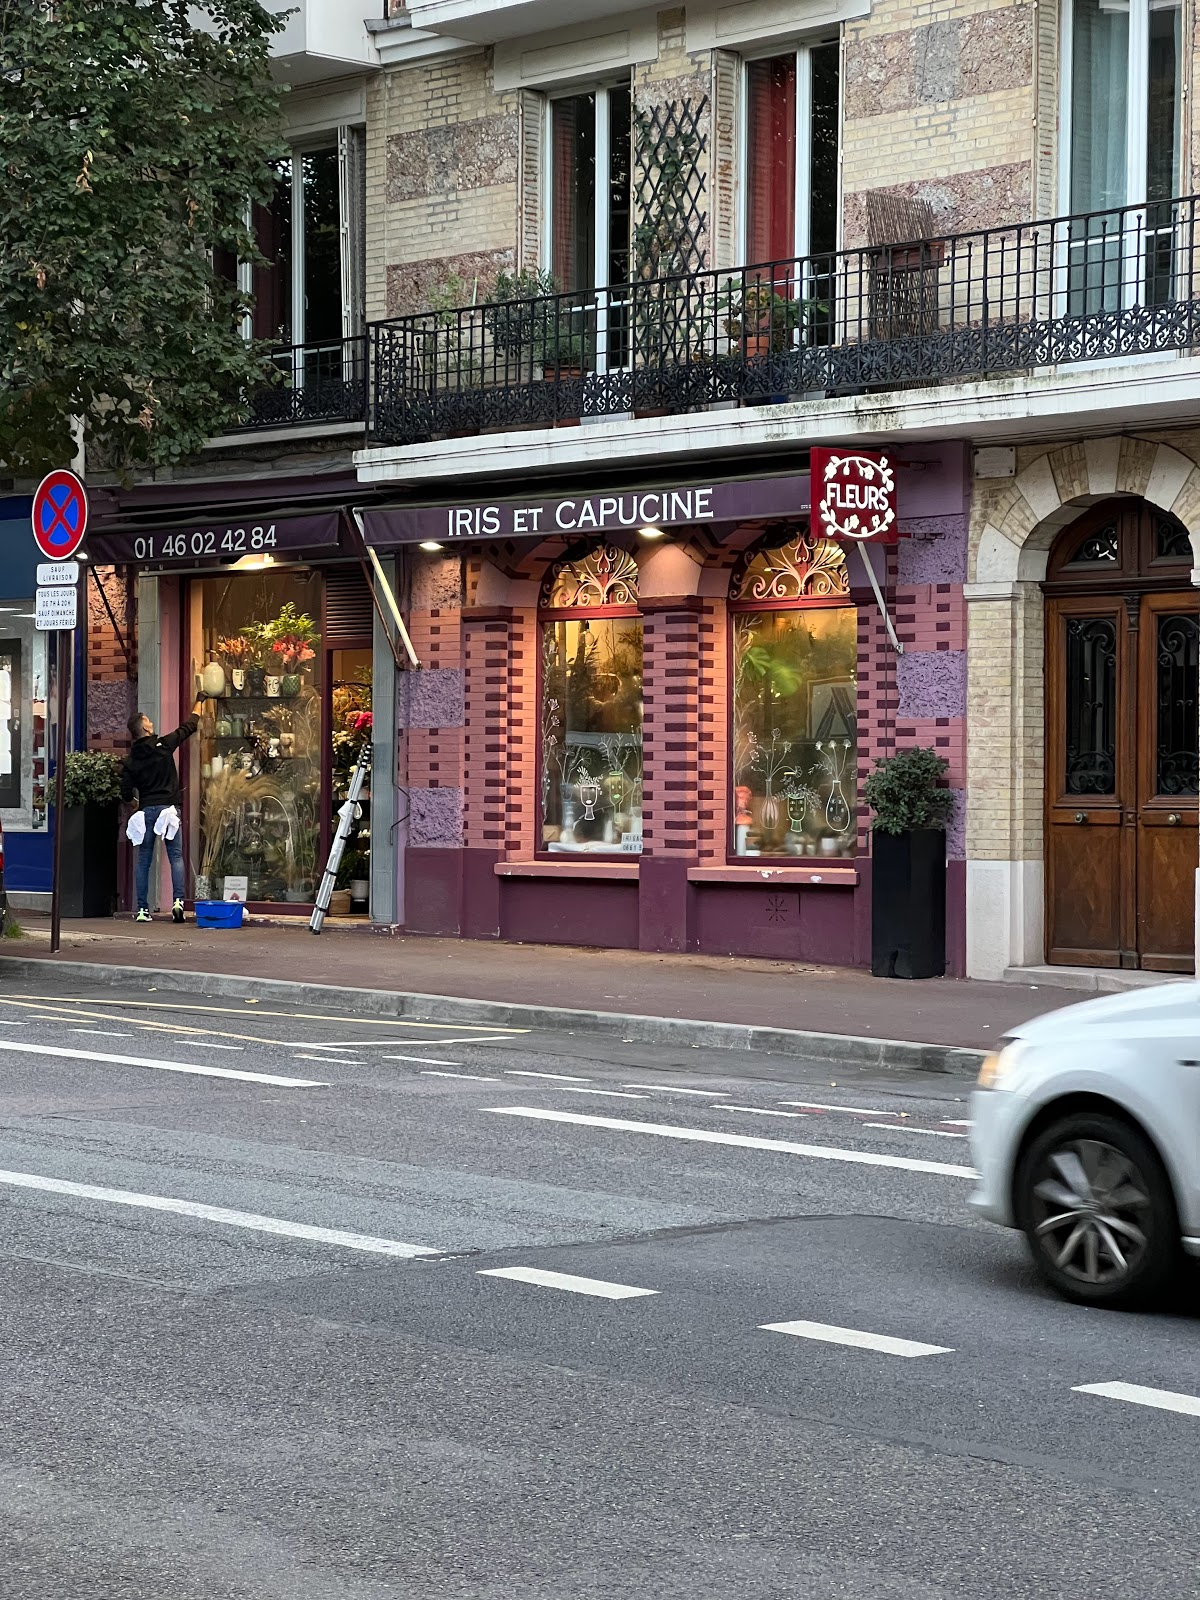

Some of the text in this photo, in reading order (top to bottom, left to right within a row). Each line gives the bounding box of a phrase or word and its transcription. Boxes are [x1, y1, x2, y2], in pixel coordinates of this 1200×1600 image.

[448, 487, 714, 536] IRIS ET CAPUCINE
[826, 482, 889, 511] FLEURS
[134, 524, 277, 559] 01 46 02 42 84
